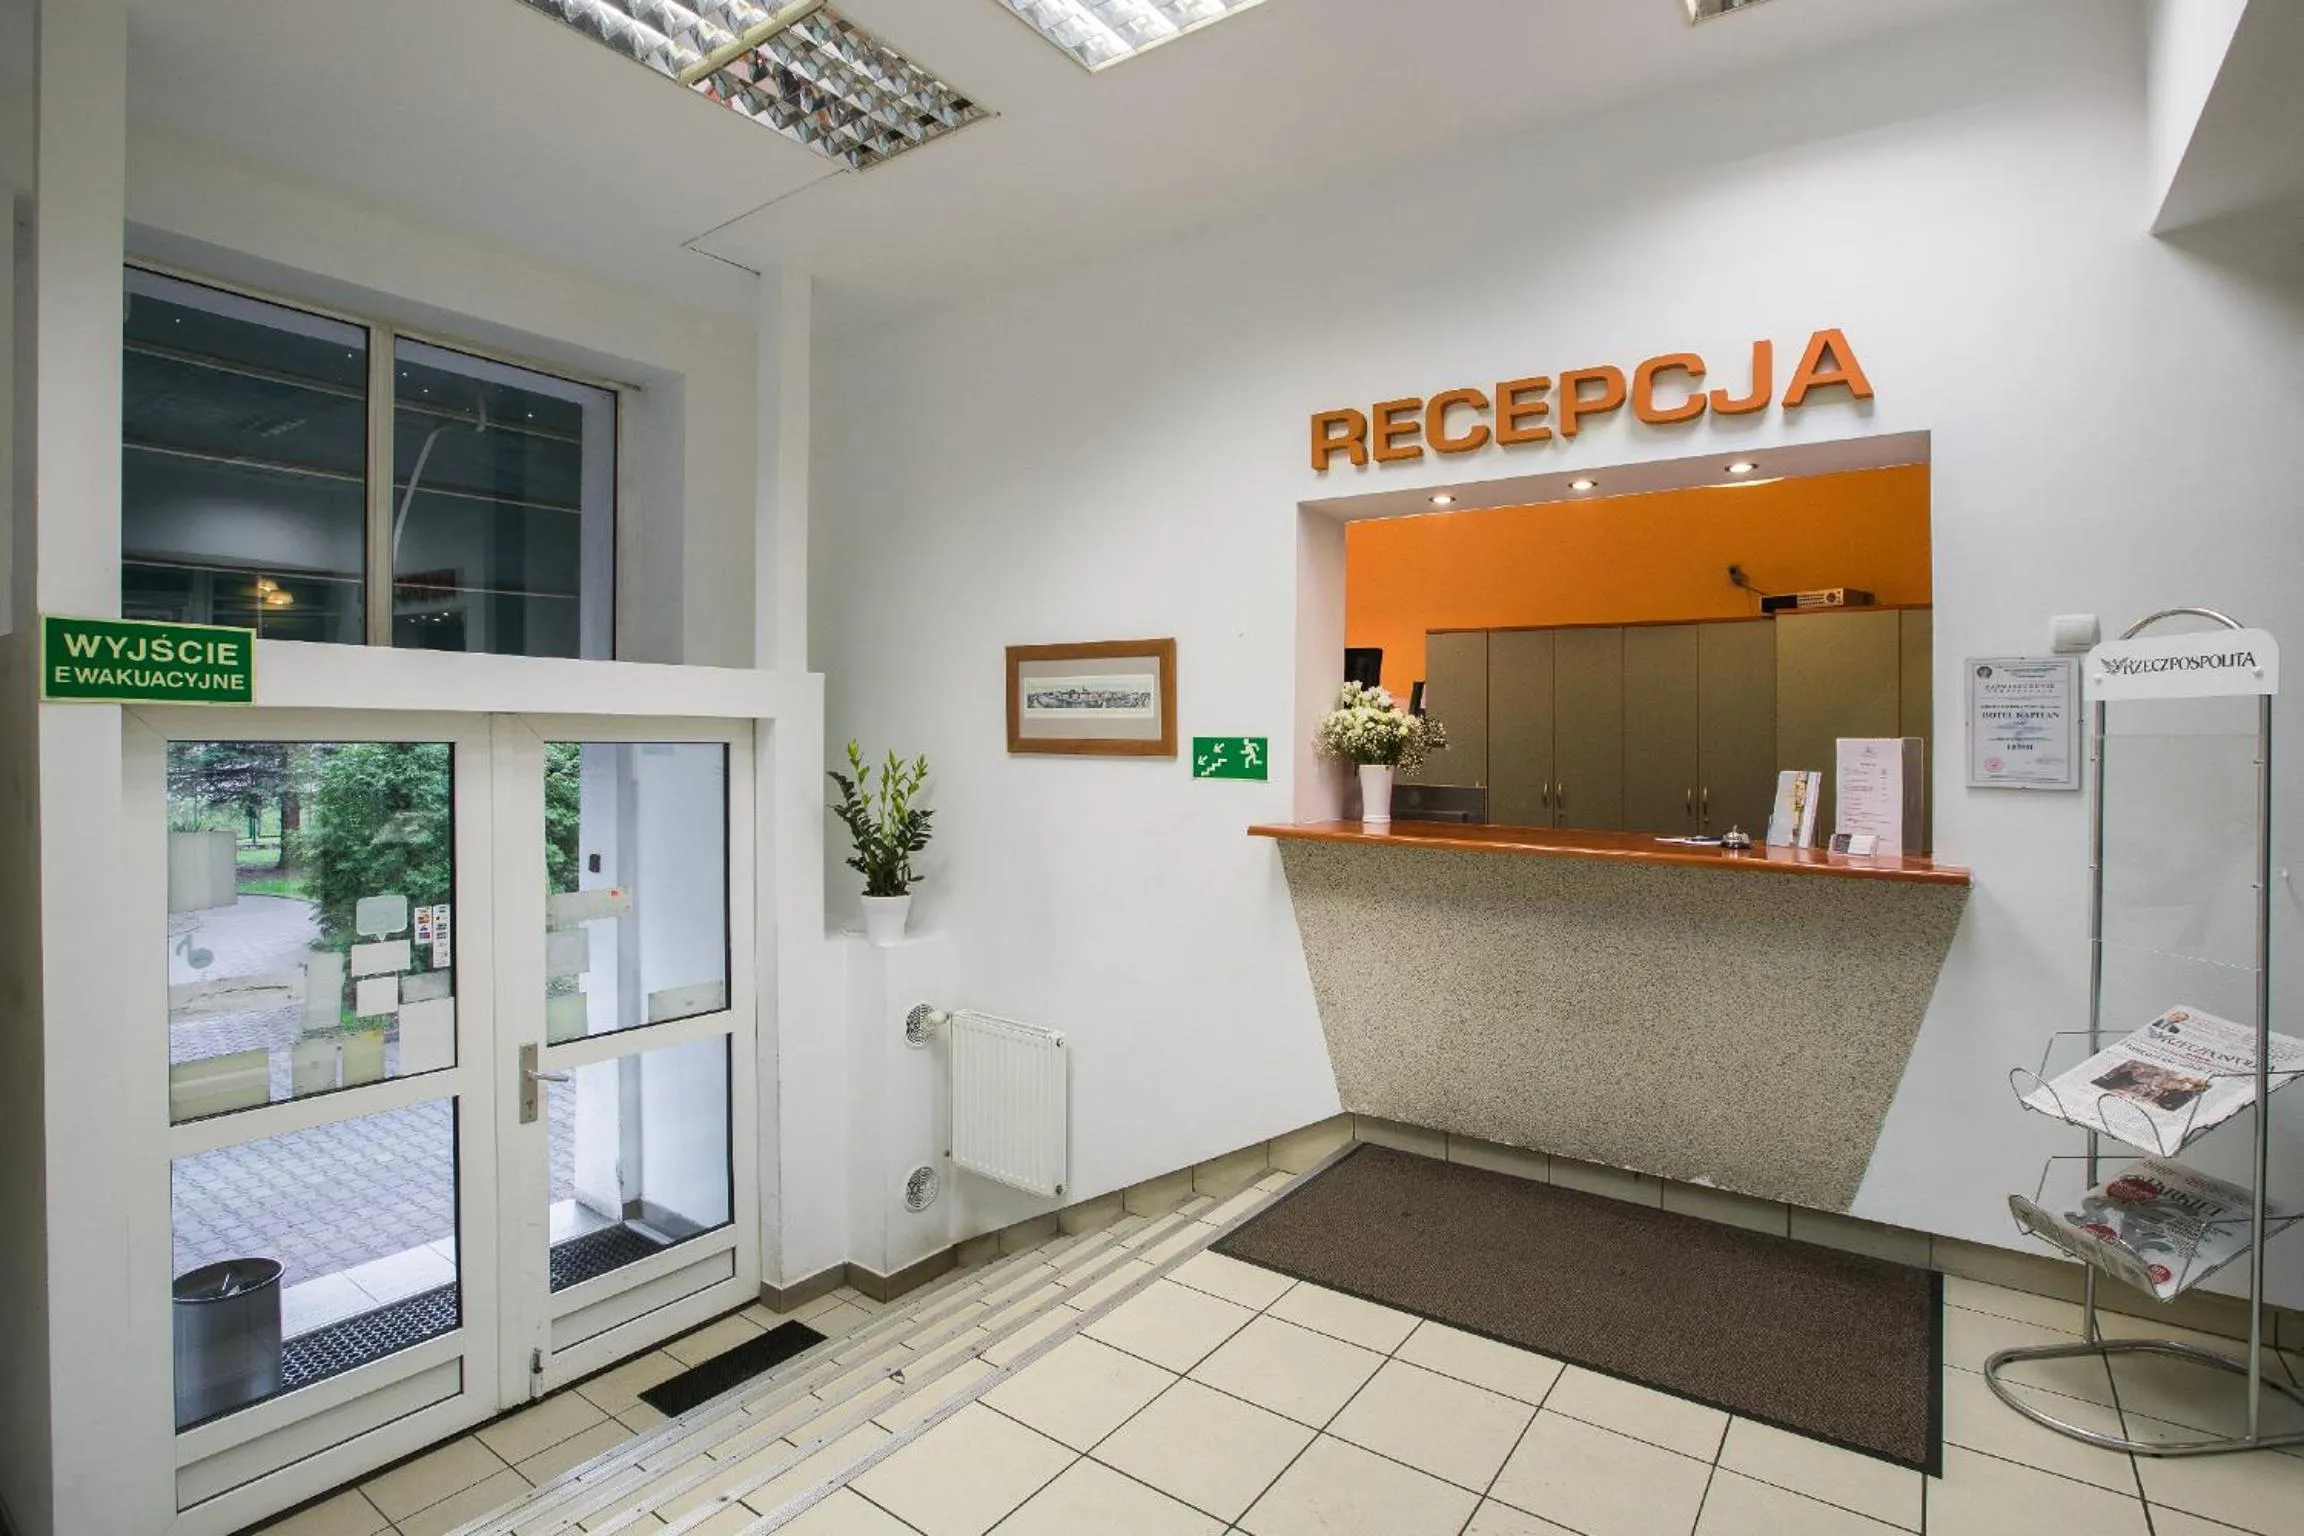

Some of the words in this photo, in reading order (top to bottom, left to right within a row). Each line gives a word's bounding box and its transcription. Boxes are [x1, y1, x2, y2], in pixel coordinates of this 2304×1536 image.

[1310, 328, 1874, 472] RECEPCJA
[64, 632, 239, 666] WYJŚCIE
[2123, 651, 2257, 676] RZECZPOSPOLITA
[54, 666, 245, 690] EWAKUACYJNE
